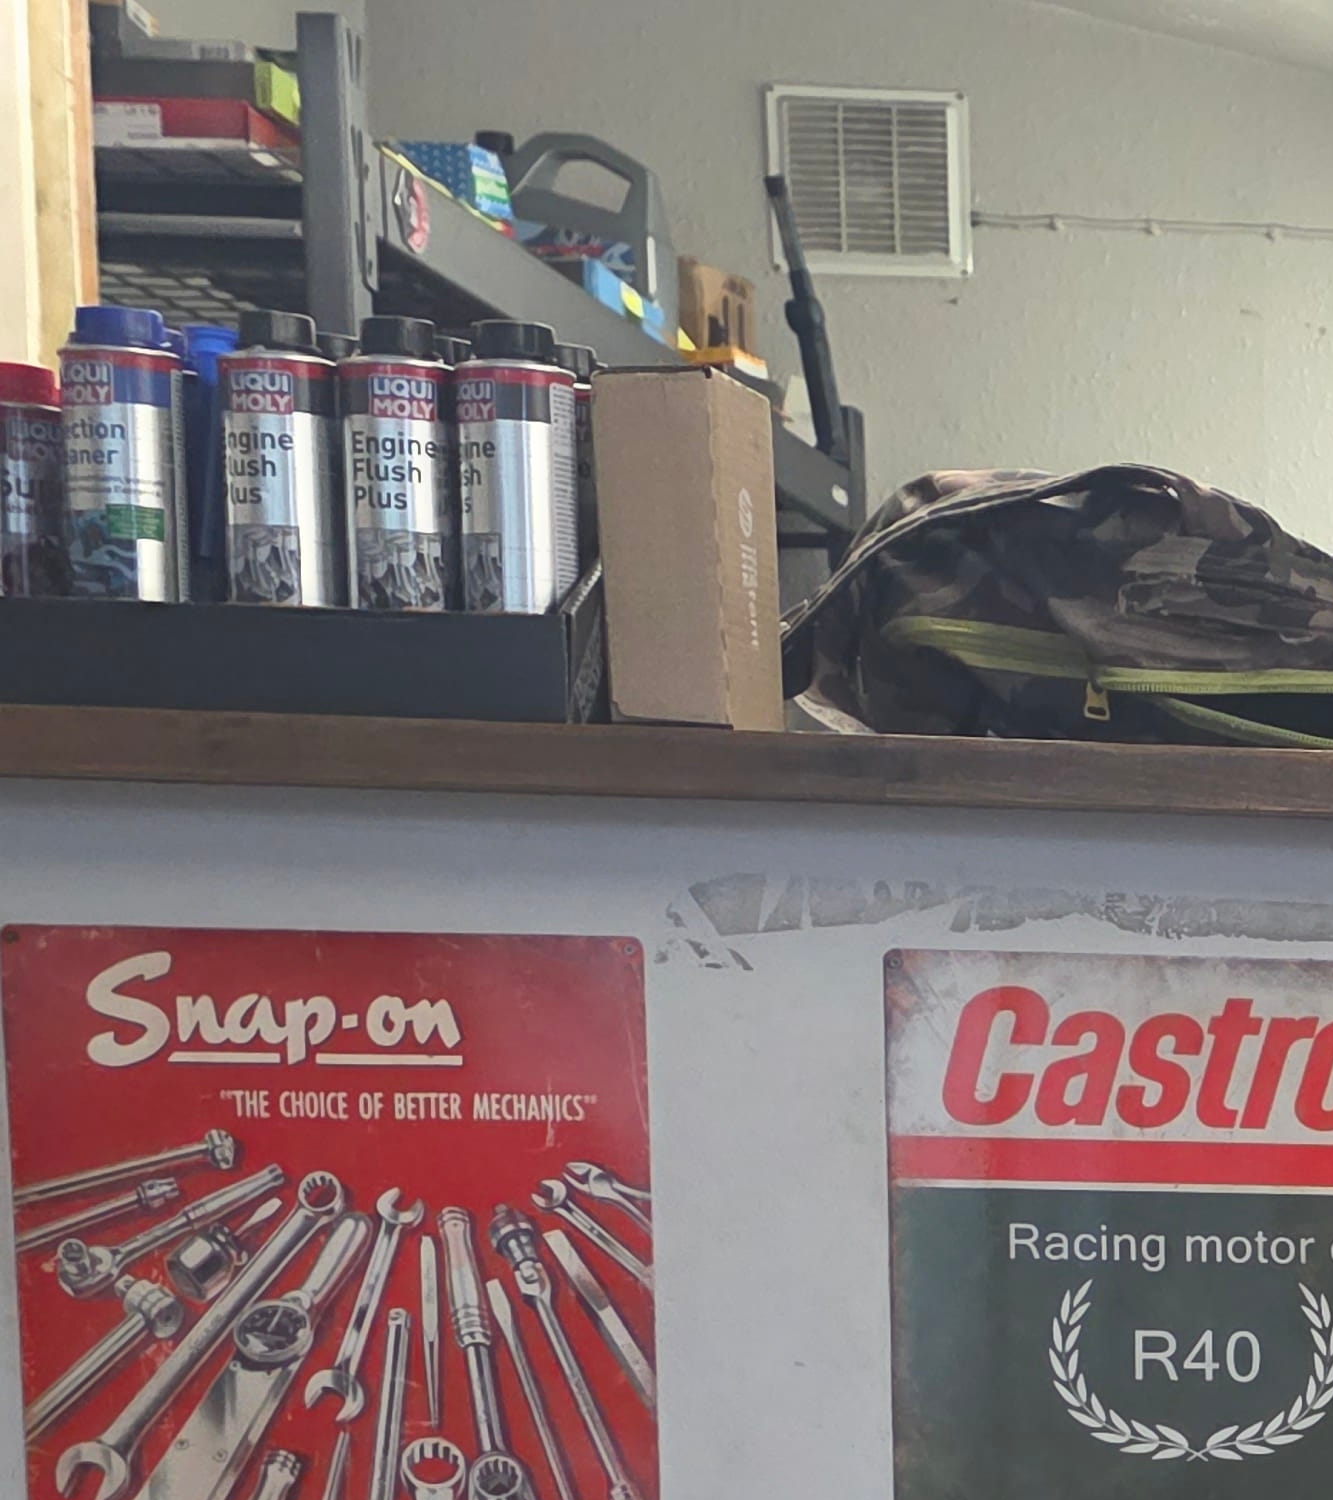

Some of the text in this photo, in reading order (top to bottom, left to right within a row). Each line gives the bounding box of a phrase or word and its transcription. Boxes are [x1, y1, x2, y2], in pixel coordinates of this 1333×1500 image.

[231, 373, 290, 392] LIQUI
[373, 378, 433, 398] LIQUI
[232, 394, 292, 412] MOLY
[373, 400, 434, 419] MOLY
[226, 426, 294, 452] ngine
[352, 430, 439, 460] Engine
[227, 455, 277, 478] lush
[353, 458, 422, 484] Flush
[354, 486, 408, 510] Plus
[86, 950, 462, 1067] Snap-on
[279, 1091, 349, 1120] CHOICE
[359, 1092, 384, 1120] OF
[394, 1092, 462, 1120] BETTER
[1008, 1222, 1167, 1272] Racing
[1184, 1232, 1315, 1266] motor
[1132, 1329, 1262, 1384] R40
